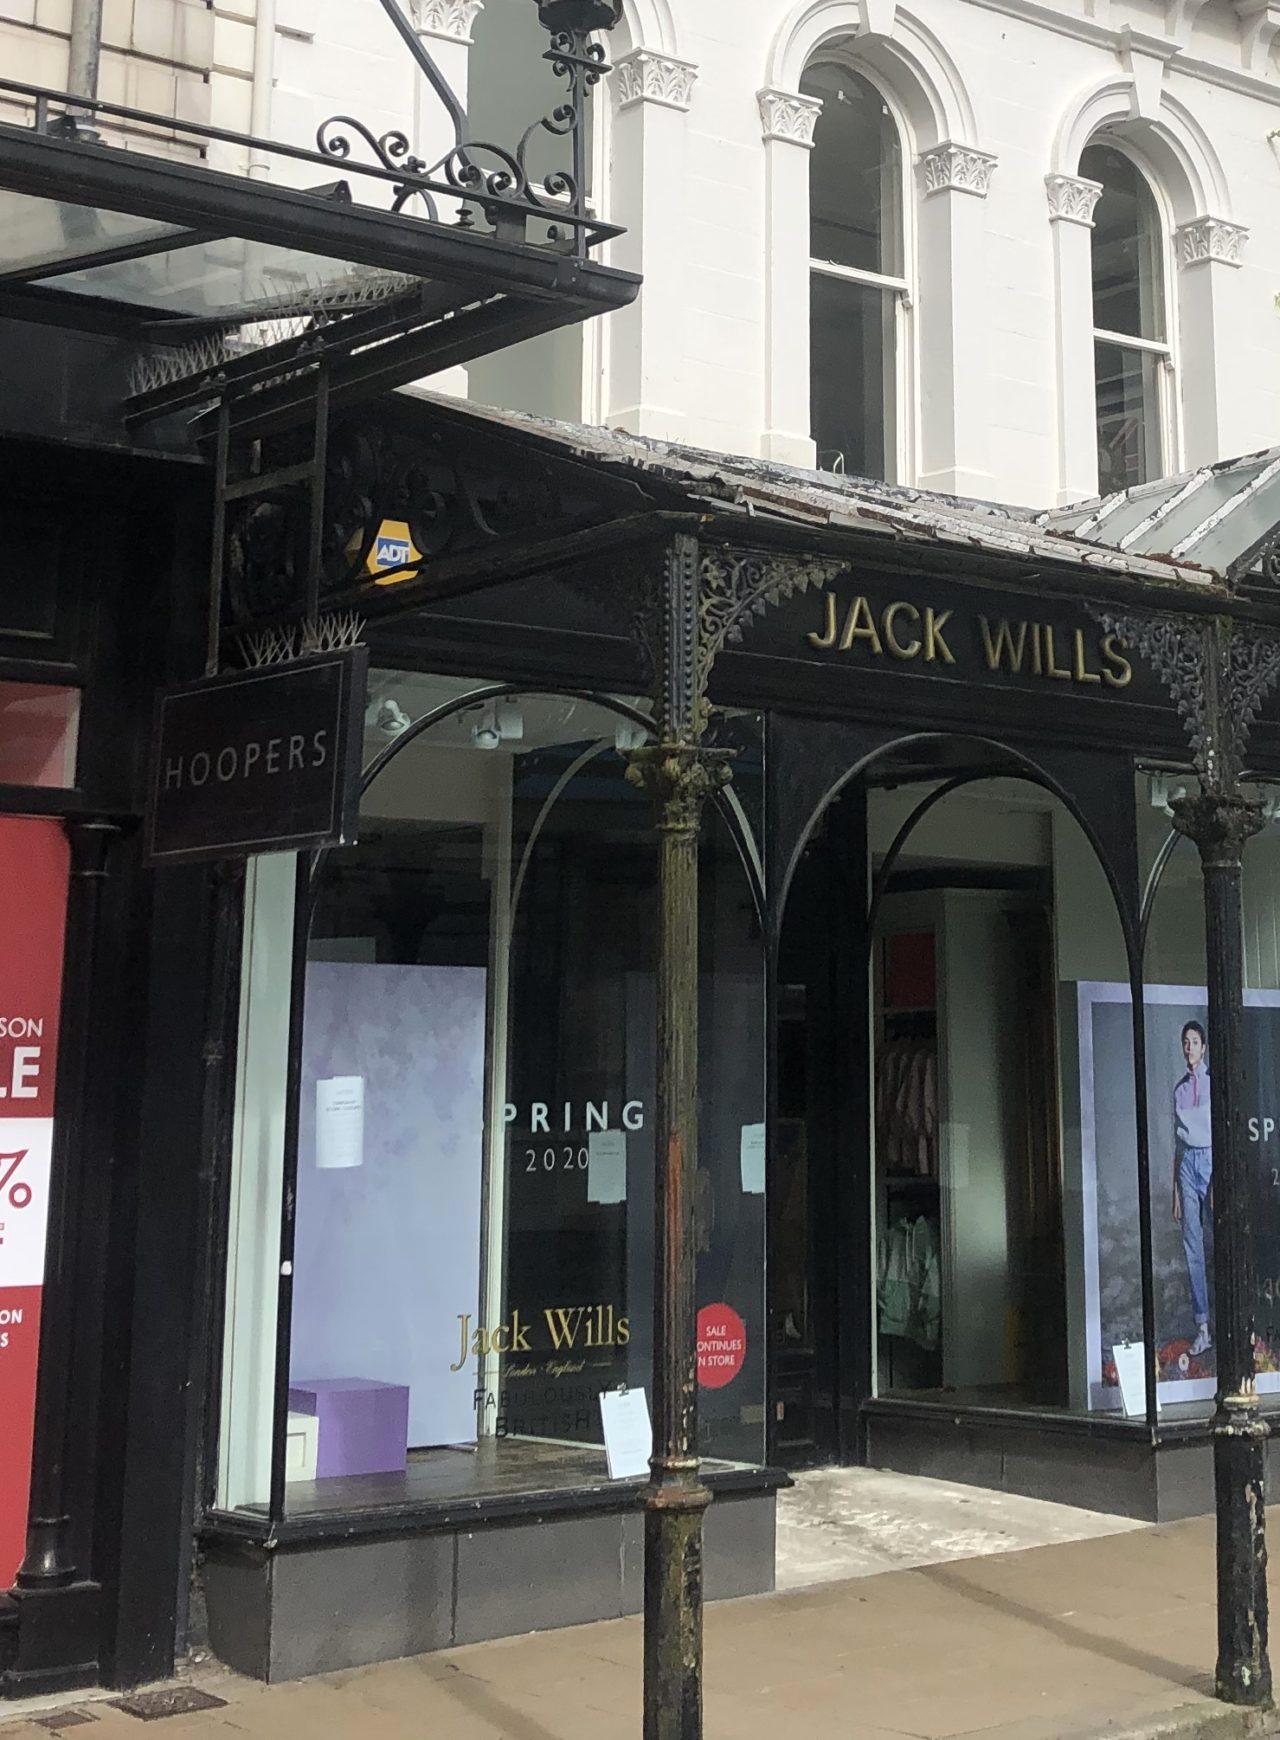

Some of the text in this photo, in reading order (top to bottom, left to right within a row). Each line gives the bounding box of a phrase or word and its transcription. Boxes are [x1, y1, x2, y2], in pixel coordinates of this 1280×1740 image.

[376, 544, 409, 564] ADT
[808, 592, 1132, 688] JACK WILLS
[165, 729, 327, 790] HOOPERS
[504, 1100, 644, 1133] PRING
[525, 1146, 589, 1172] 2020
[449, 1304, 630, 1372] Jack Wills
[706, 1324, 727, 1337] SALE
[696, 1339, 742, 1352] ONTINUES
[707, 1354, 735, 1367] STORE
